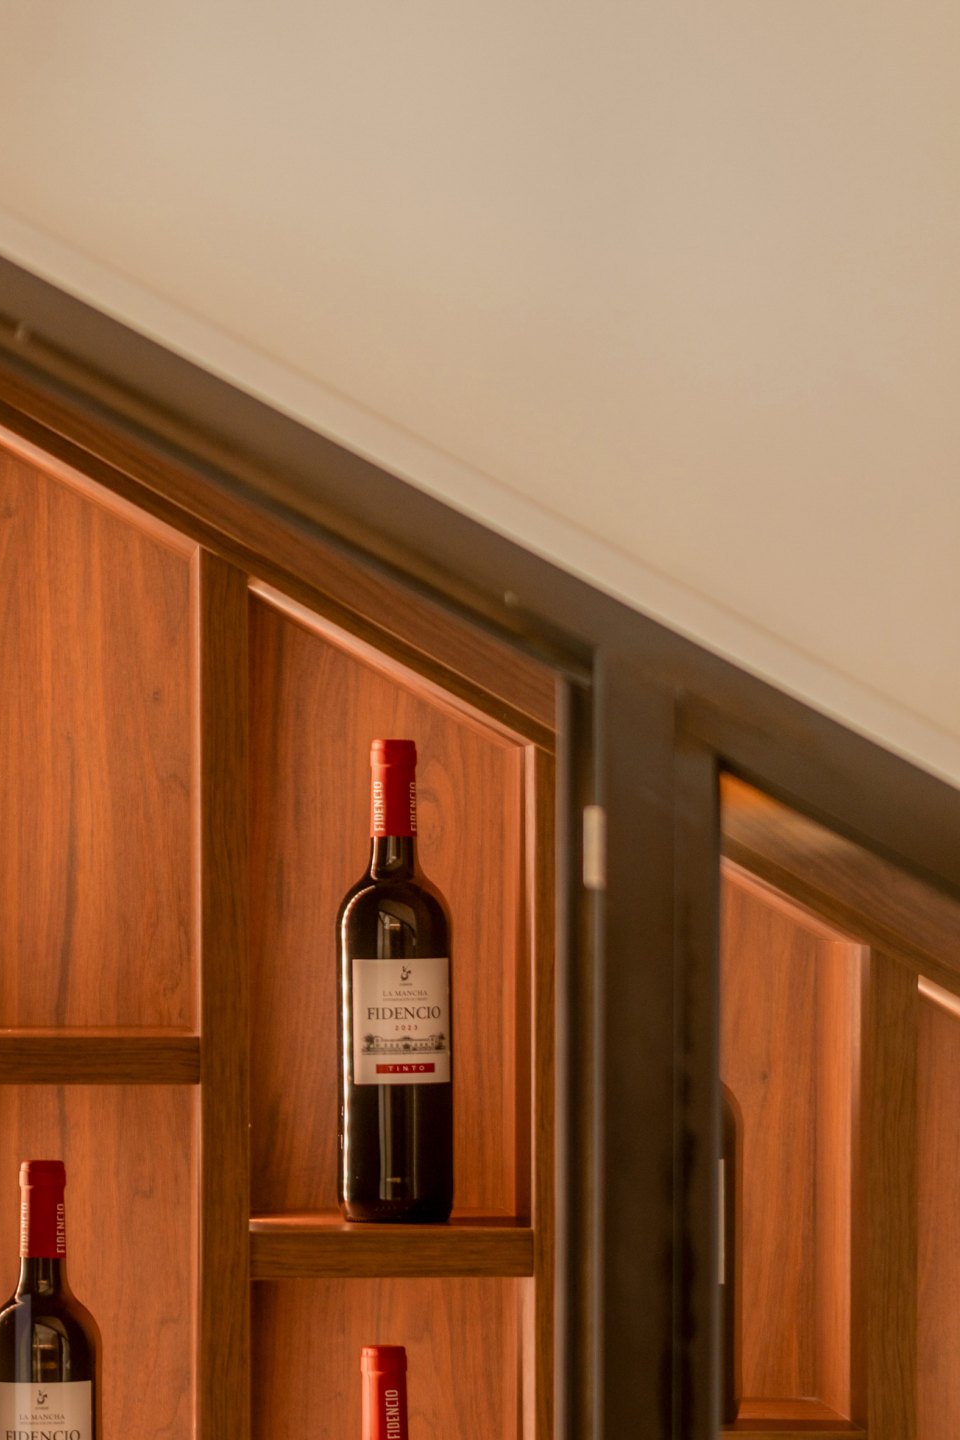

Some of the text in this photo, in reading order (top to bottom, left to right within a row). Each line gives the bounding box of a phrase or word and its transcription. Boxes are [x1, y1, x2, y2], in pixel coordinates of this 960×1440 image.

[373, 781, 385, 832] FIDENCIO
[367, 1005, 442, 1020] FIDENCIO
[385, 1389, 400, 1439] FIDENCIO
